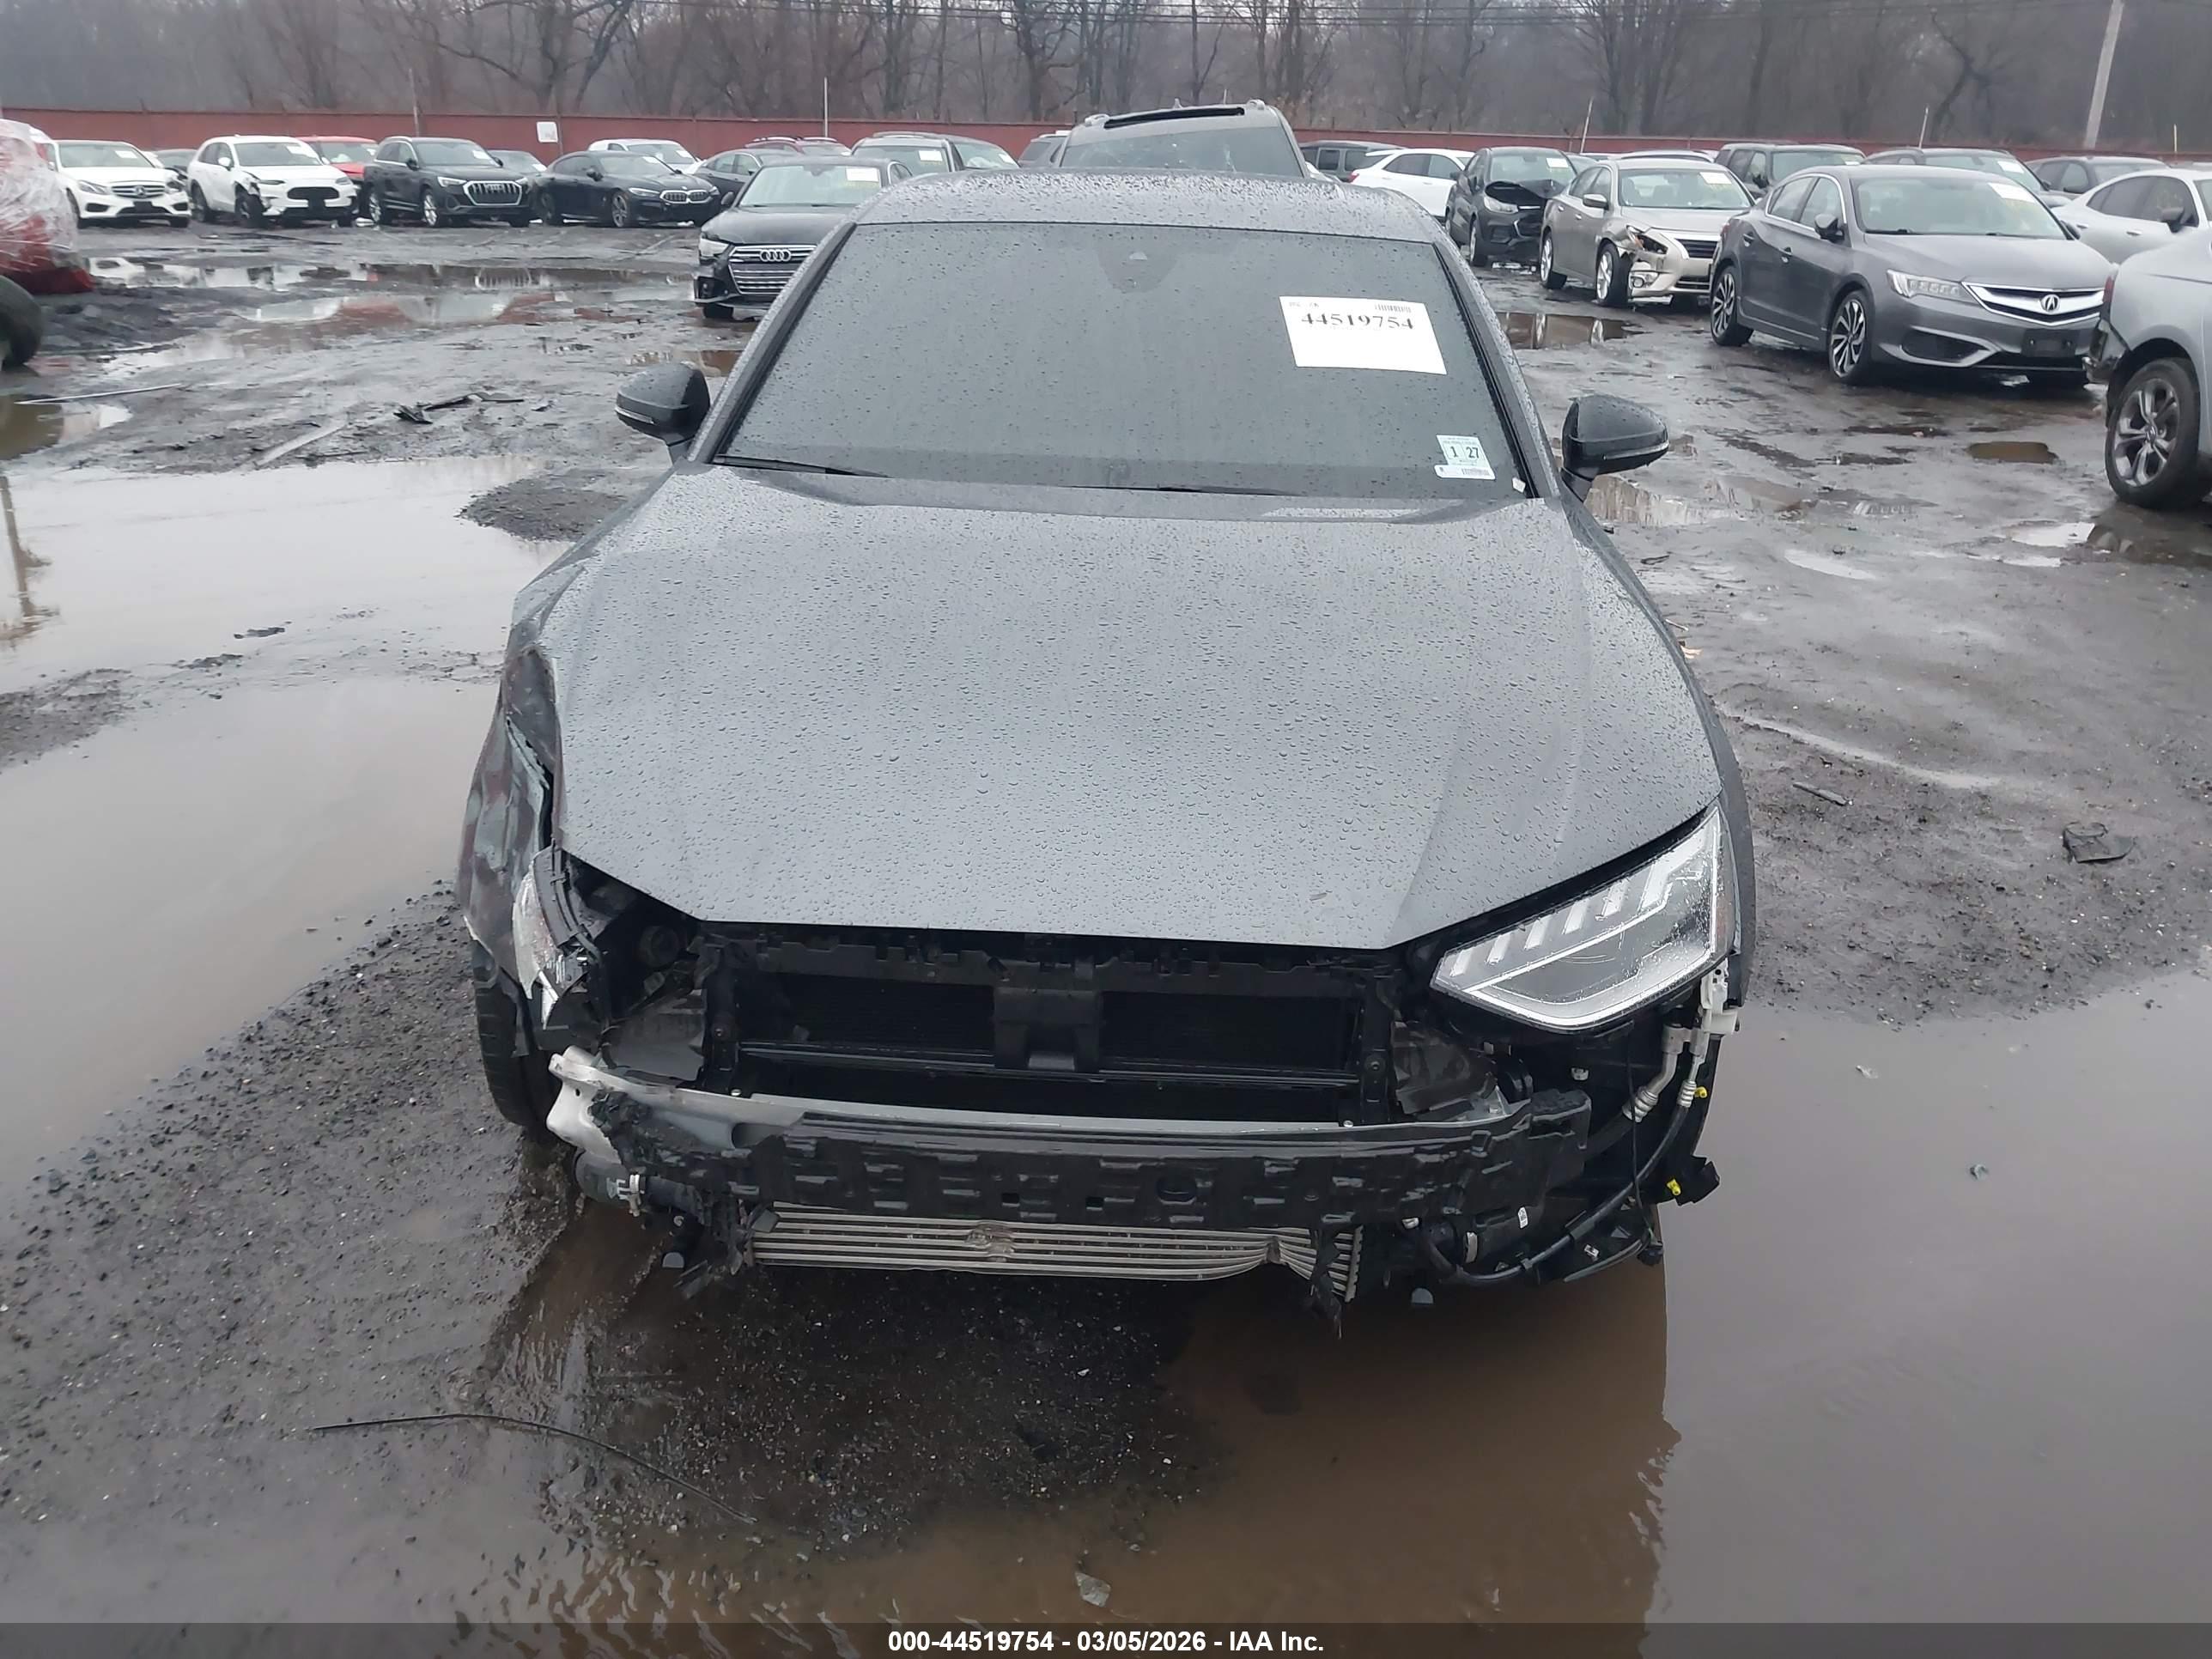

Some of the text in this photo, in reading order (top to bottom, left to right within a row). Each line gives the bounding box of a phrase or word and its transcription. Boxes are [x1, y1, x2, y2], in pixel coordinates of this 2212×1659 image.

[1301, 313, 1413, 330] 44519754
[1450, 446, 1480, 459] 1 27
